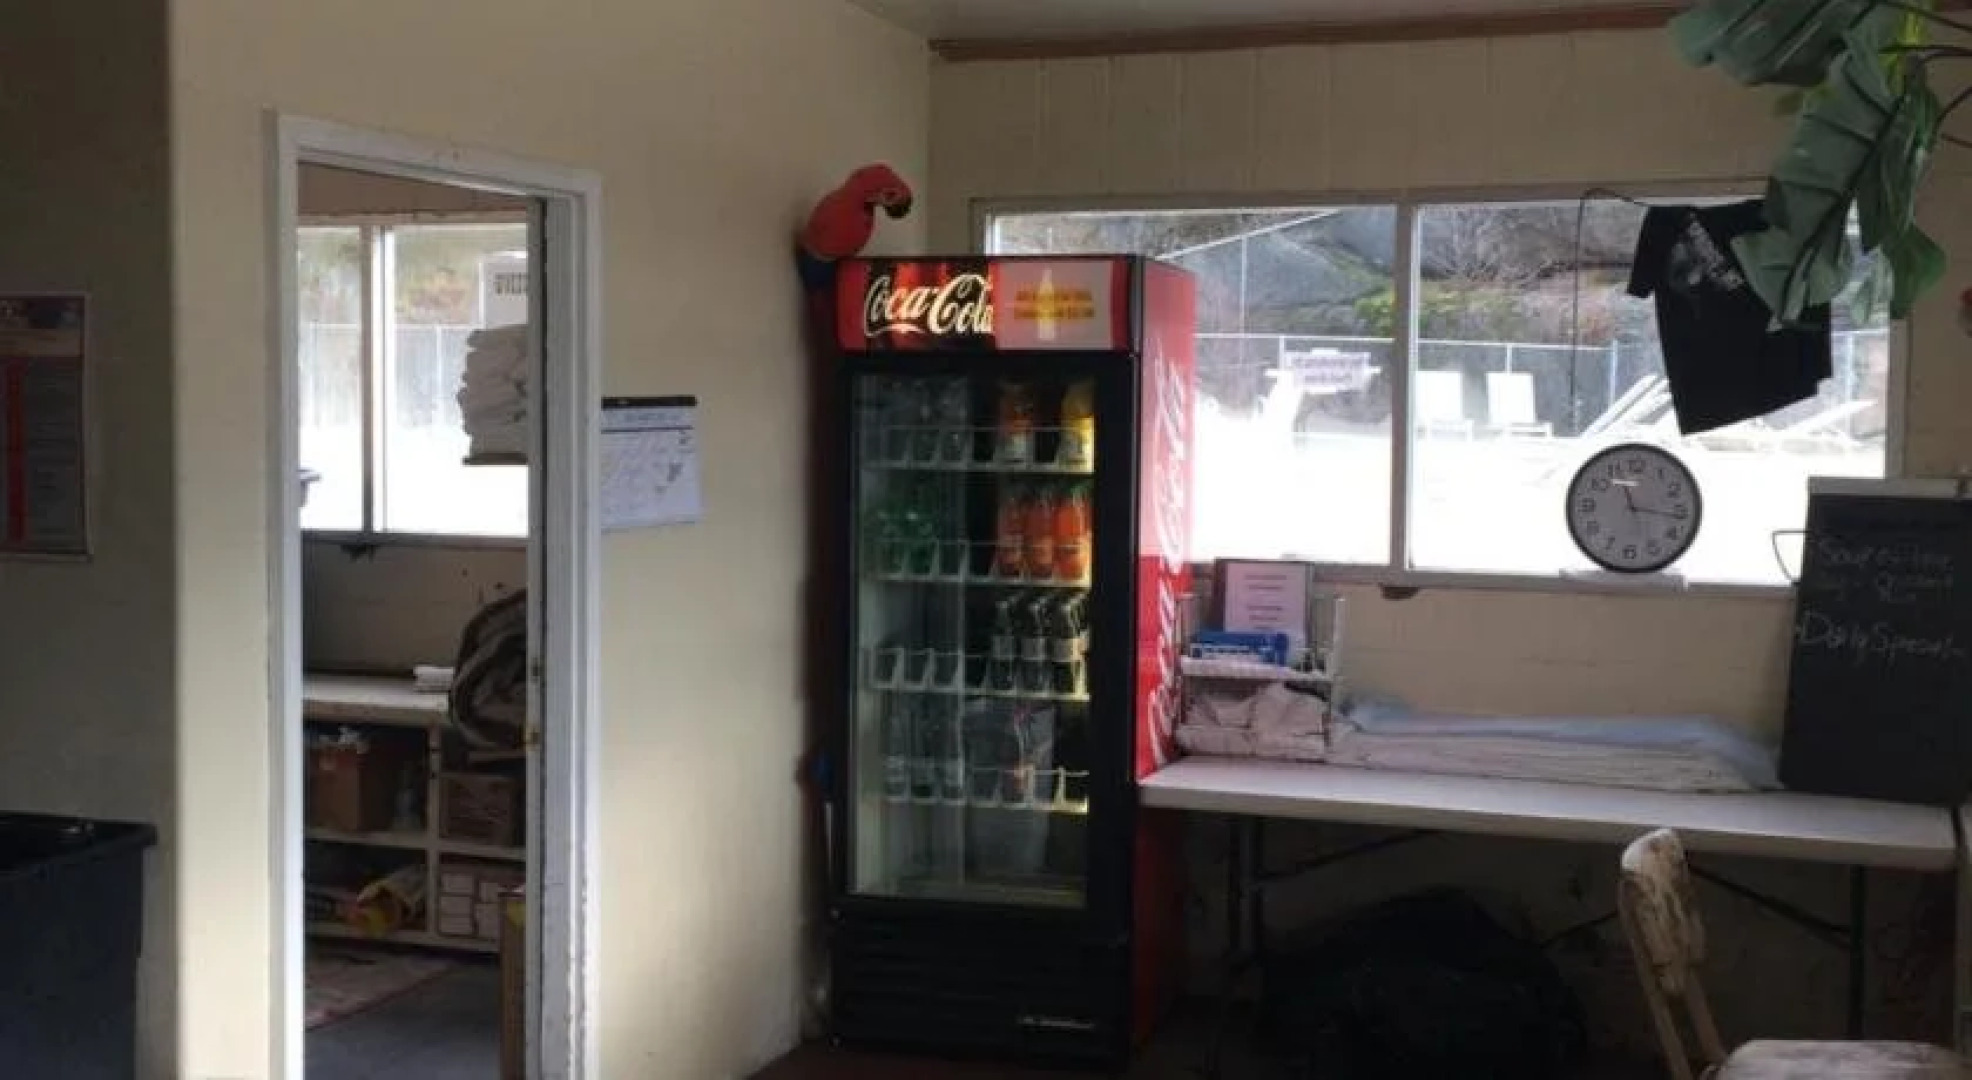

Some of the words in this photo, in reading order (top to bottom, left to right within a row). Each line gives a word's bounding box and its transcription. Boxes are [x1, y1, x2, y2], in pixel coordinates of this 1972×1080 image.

[865, 274, 993, 337] Coca-Cola
[1627, 458, 1647, 474] 12
[1591, 478, 1609, 492] 10
[1667, 482, 1682, 499] 2
[1581, 497, 1596, 513] 9
[1673, 504, 1689, 520] 3
[1622, 544, 1637, 560] 6
